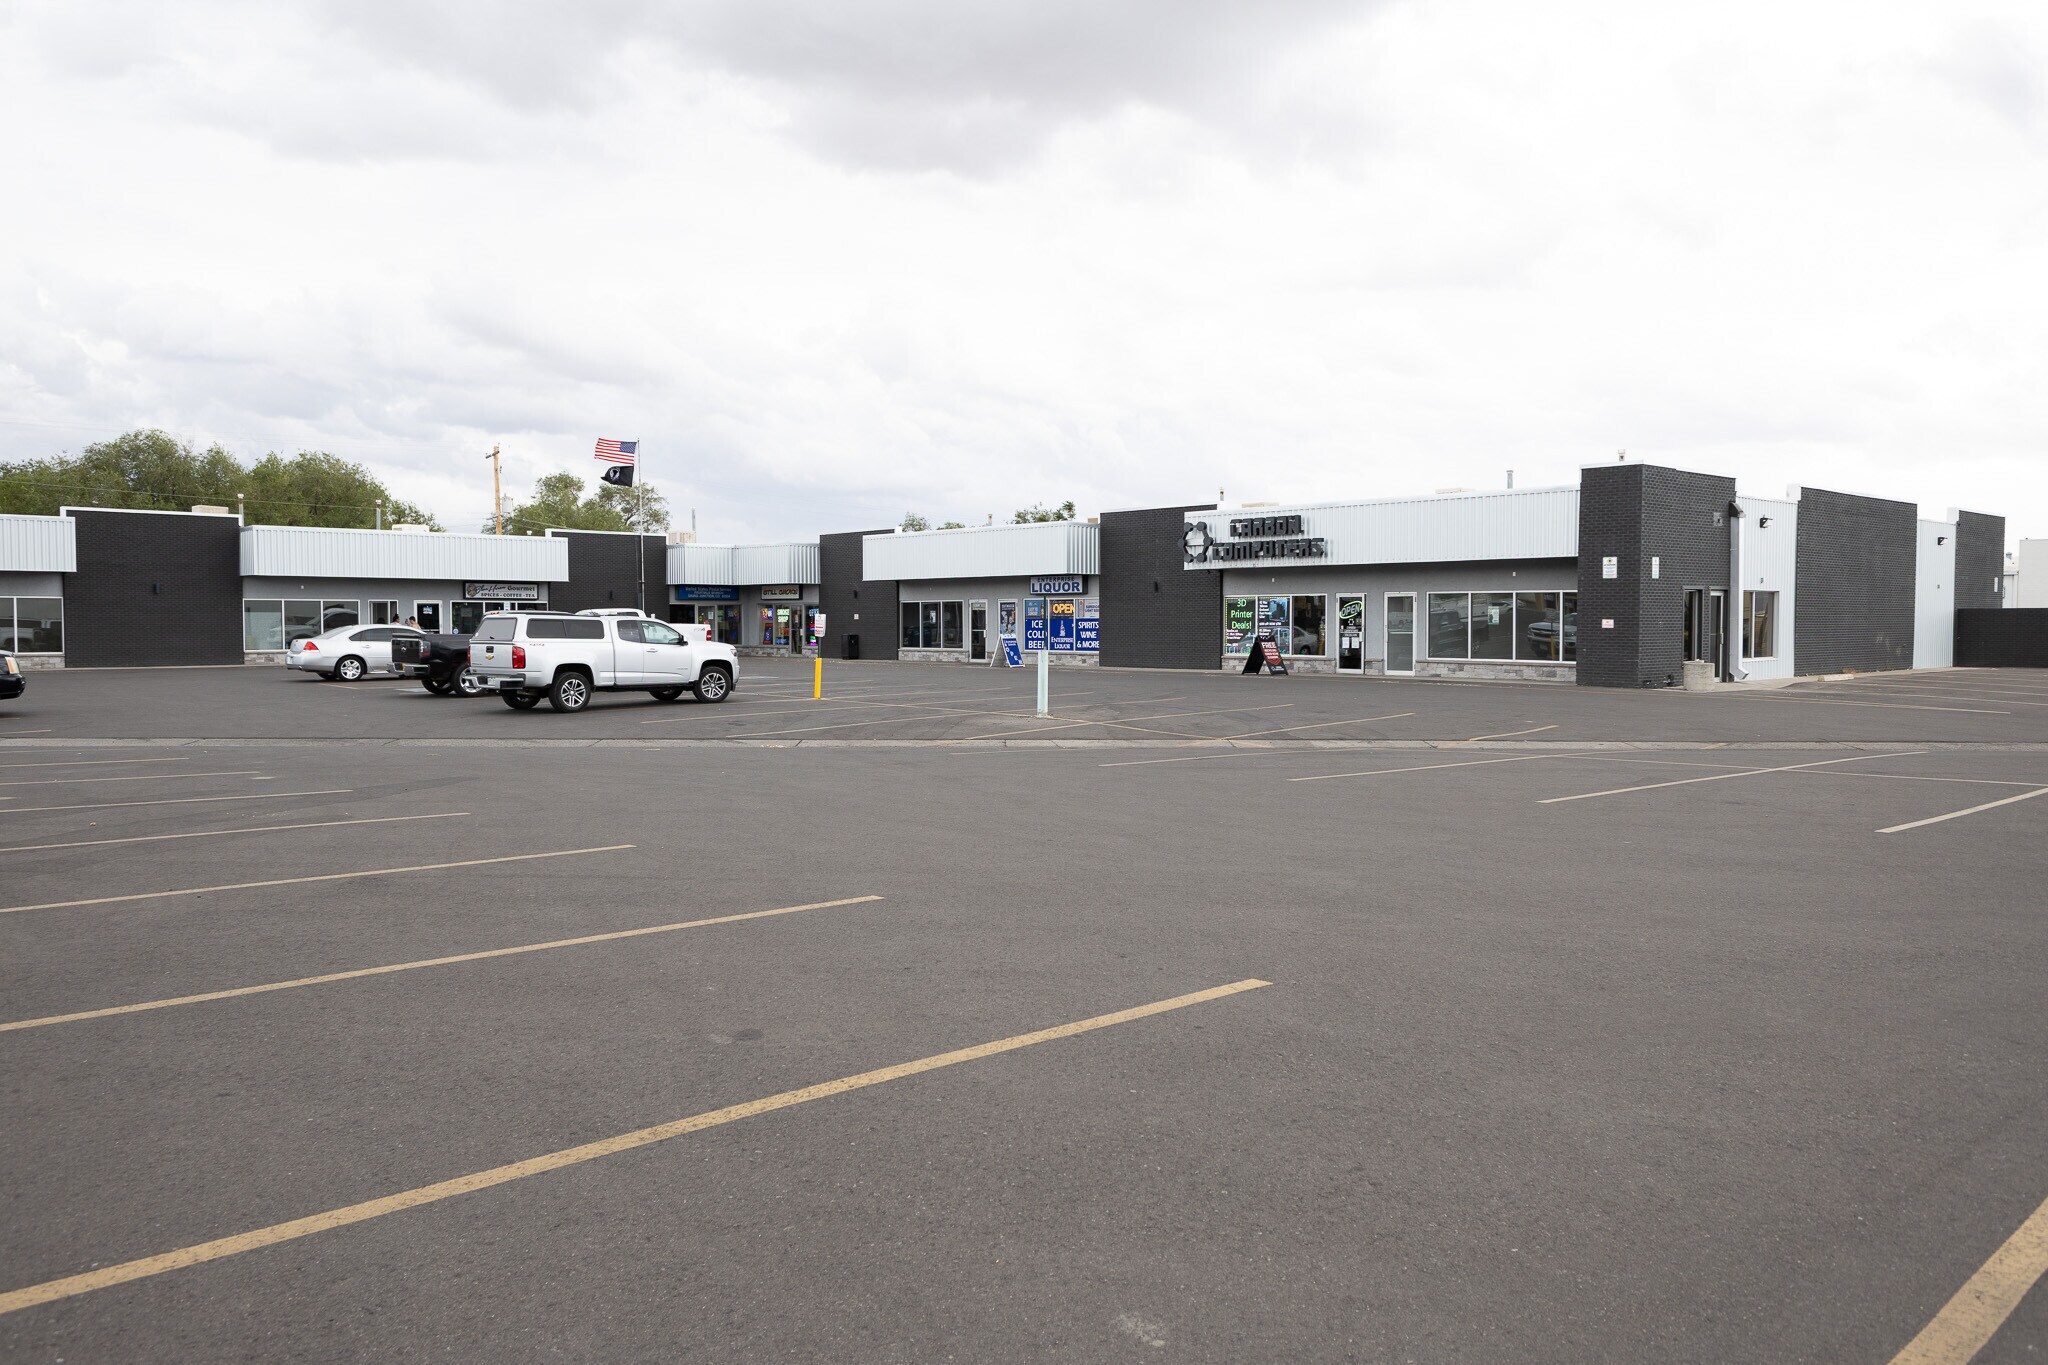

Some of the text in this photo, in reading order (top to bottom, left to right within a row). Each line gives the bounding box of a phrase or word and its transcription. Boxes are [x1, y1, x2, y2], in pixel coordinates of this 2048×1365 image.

[1230, 515, 1303, 537] CARBON
[1212, 538, 1324, 560] COMPUTERS
[1031, 582, 1080, 593] LIQUOR
[1237, 598, 1246, 607] 3D
[777, 608, 790, 616] SMOKE
[1053, 604, 1074, 614] OPEN
[1341, 603, 1360, 616] OPEN
[1230, 610, 1253, 618] Printer
[777, 615, 789, 623] SHOP
[1031, 620, 1043, 628] ICE
[1078, 621, 1099, 629] SPIRITS
[1231, 621, 1252, 629] Deals!
[1080, 631, 1097, 639] WINE
